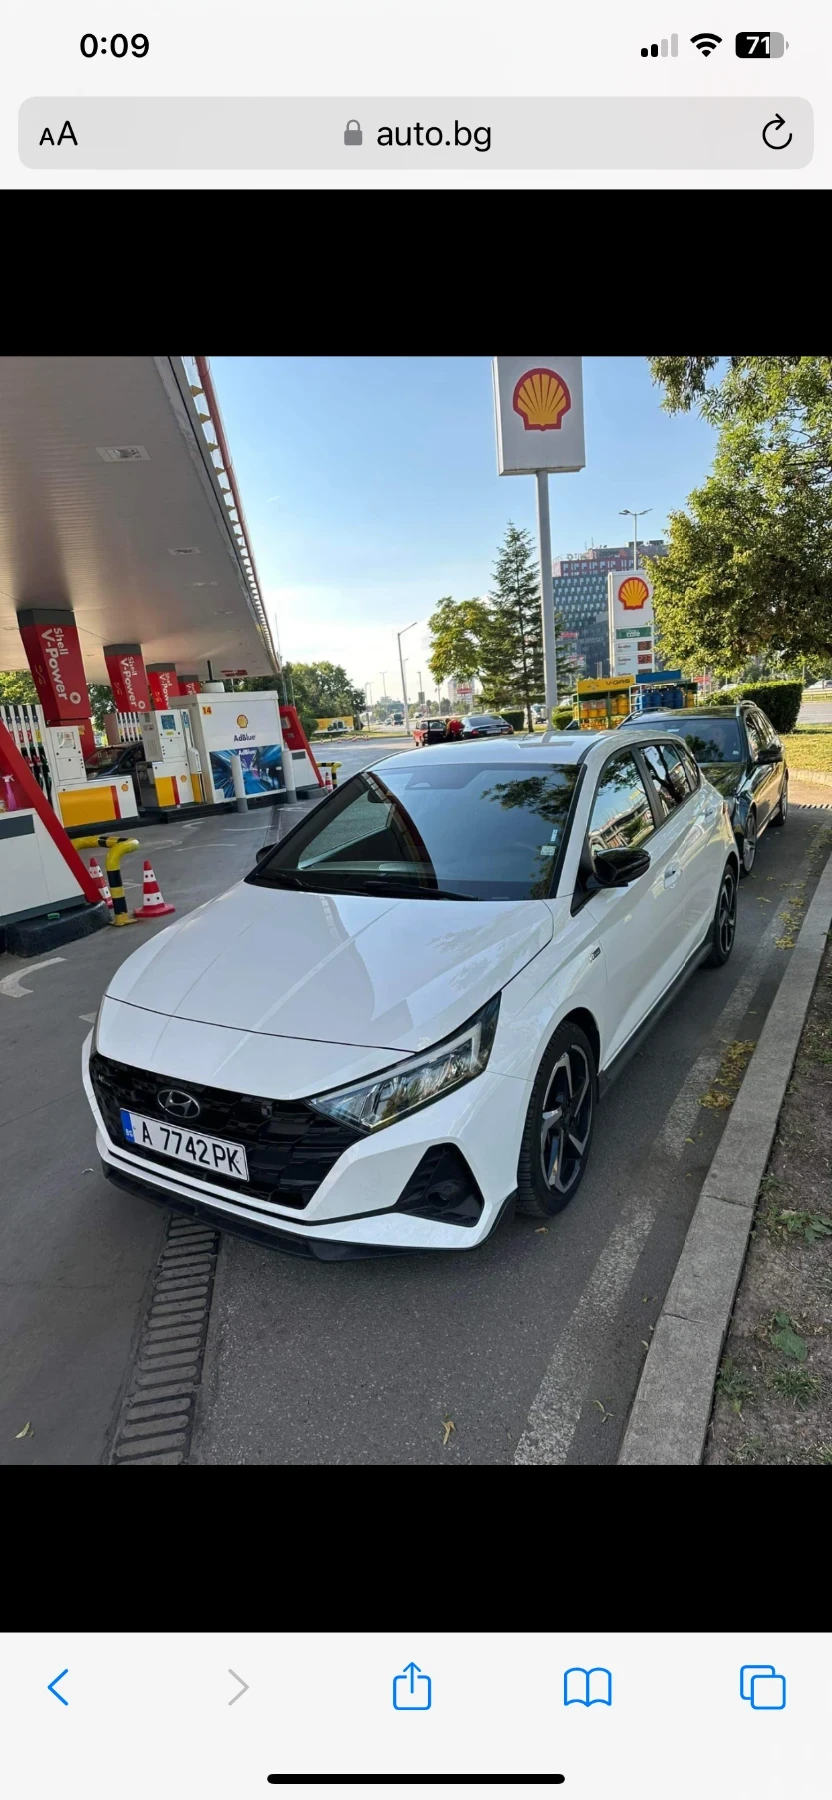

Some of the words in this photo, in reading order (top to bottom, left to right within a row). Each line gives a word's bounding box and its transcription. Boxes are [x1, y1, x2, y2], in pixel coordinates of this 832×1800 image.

[53, 627, 69, 655] Shell
[41, 628, 68, 700] V-Power
[121, 658, 137, 707] V-Power
[202, 706, 212, 715] 14
[233, 733, 256, 742] AdBlue
[142, 1121, 153, 1146] A
